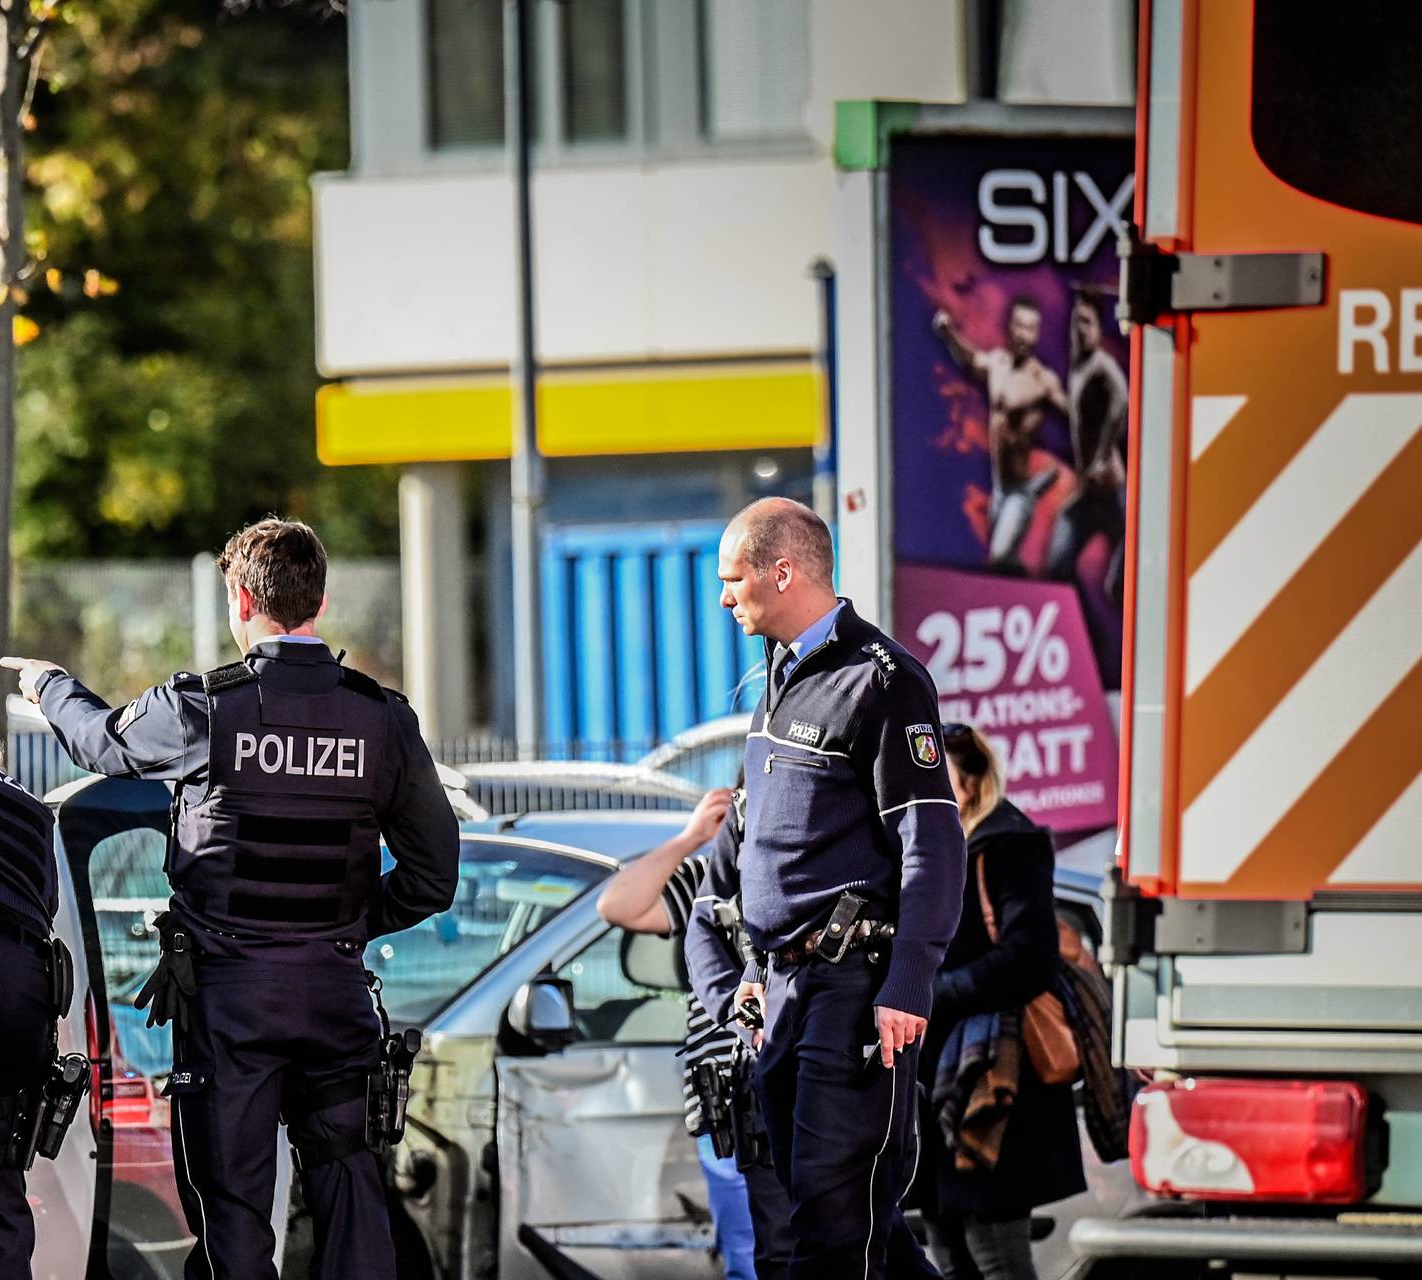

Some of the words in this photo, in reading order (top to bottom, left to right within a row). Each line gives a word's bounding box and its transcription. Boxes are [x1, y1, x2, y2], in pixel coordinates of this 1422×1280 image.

[916, 600, 1070, 697] 25%
[234, 732, 365, 778] POLIZEI
[788, 722, 821, 743] POLIZEI
